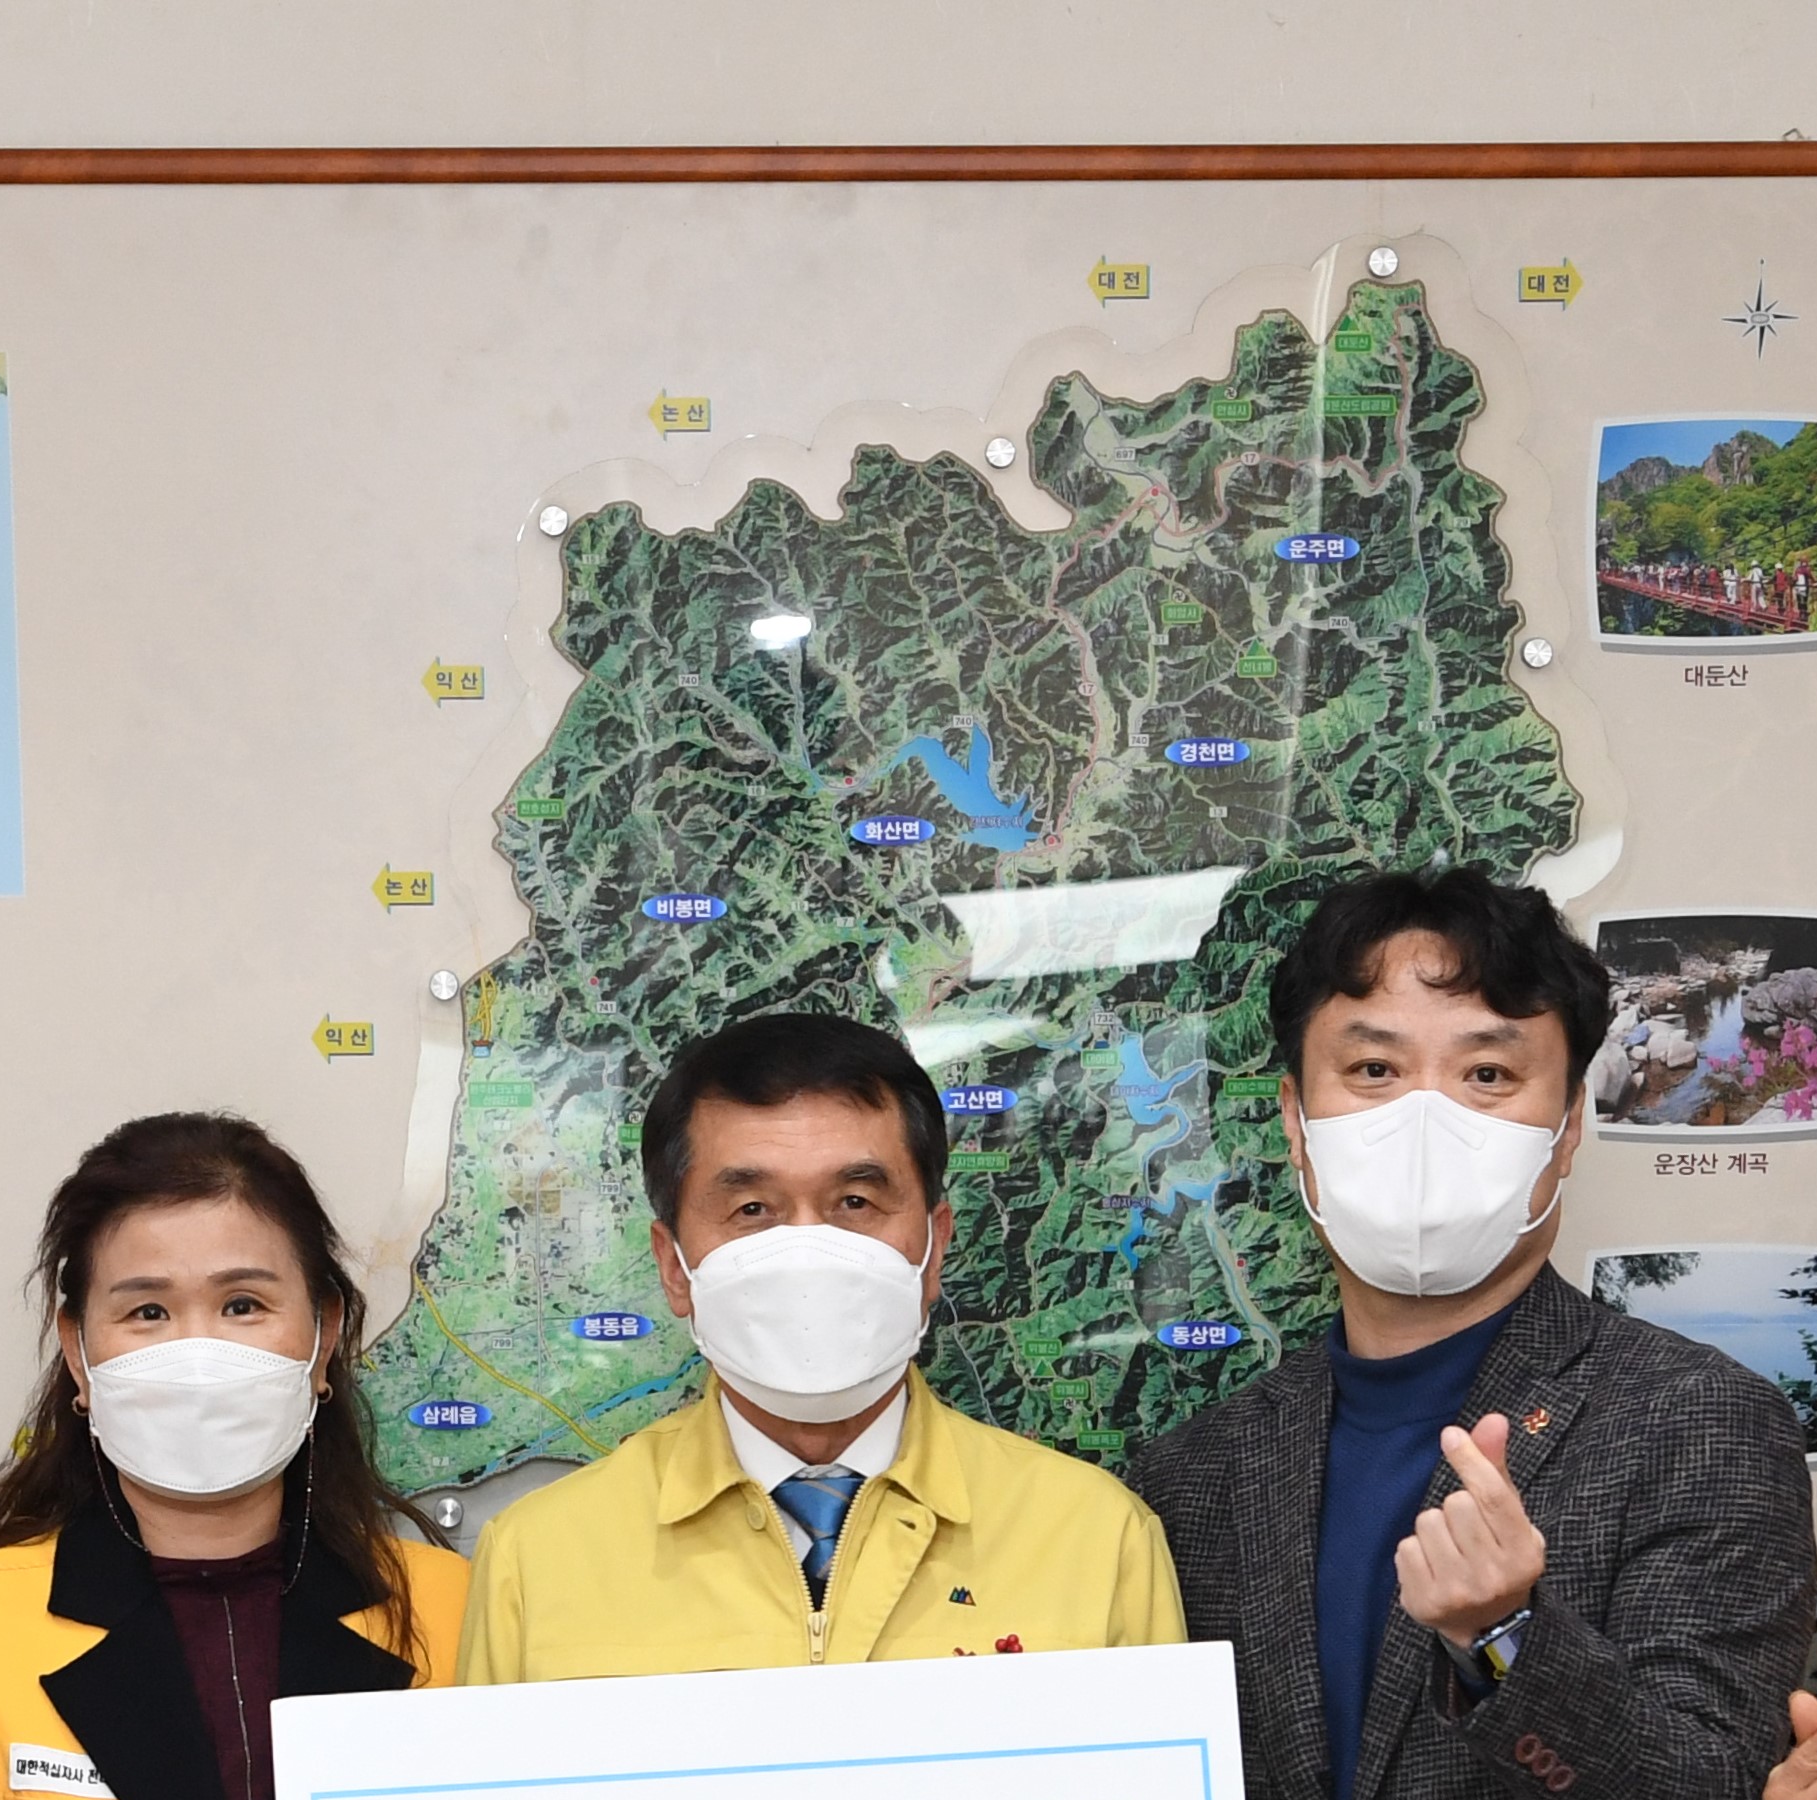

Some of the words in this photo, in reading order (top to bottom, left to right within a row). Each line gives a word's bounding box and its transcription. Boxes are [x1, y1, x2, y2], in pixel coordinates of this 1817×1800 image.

[1115, 449, 1135, 460] 697
[1244, 453, 1256, 463] 17
[1289, 539, 1344, 558] 운주면
[1684, 664, 1749, 687] 대둔산
[955, 716, 972, 726] 740
[1131, 736, 1147, 745] 740
[1180, 744, 1235, 761] 경천면
[865, 822, 919, 840] 화산면
[656, 900, 711, 918] 비봉면
[948, 1092, 1003, 1110] 고산면
[1653, 1152, 1719, 1176] 운장산
[1727, 1152, 1769, 1175] 계곡
[601, 1183, 619, 1193] 799
[584, 1318, 638, 1337] 봉동읍
[1172, 1326, 1226, 1345] 동상면
[494, 1339, 512, 1347] 799
[423, 1406, 477, 1425] 삼례읍
